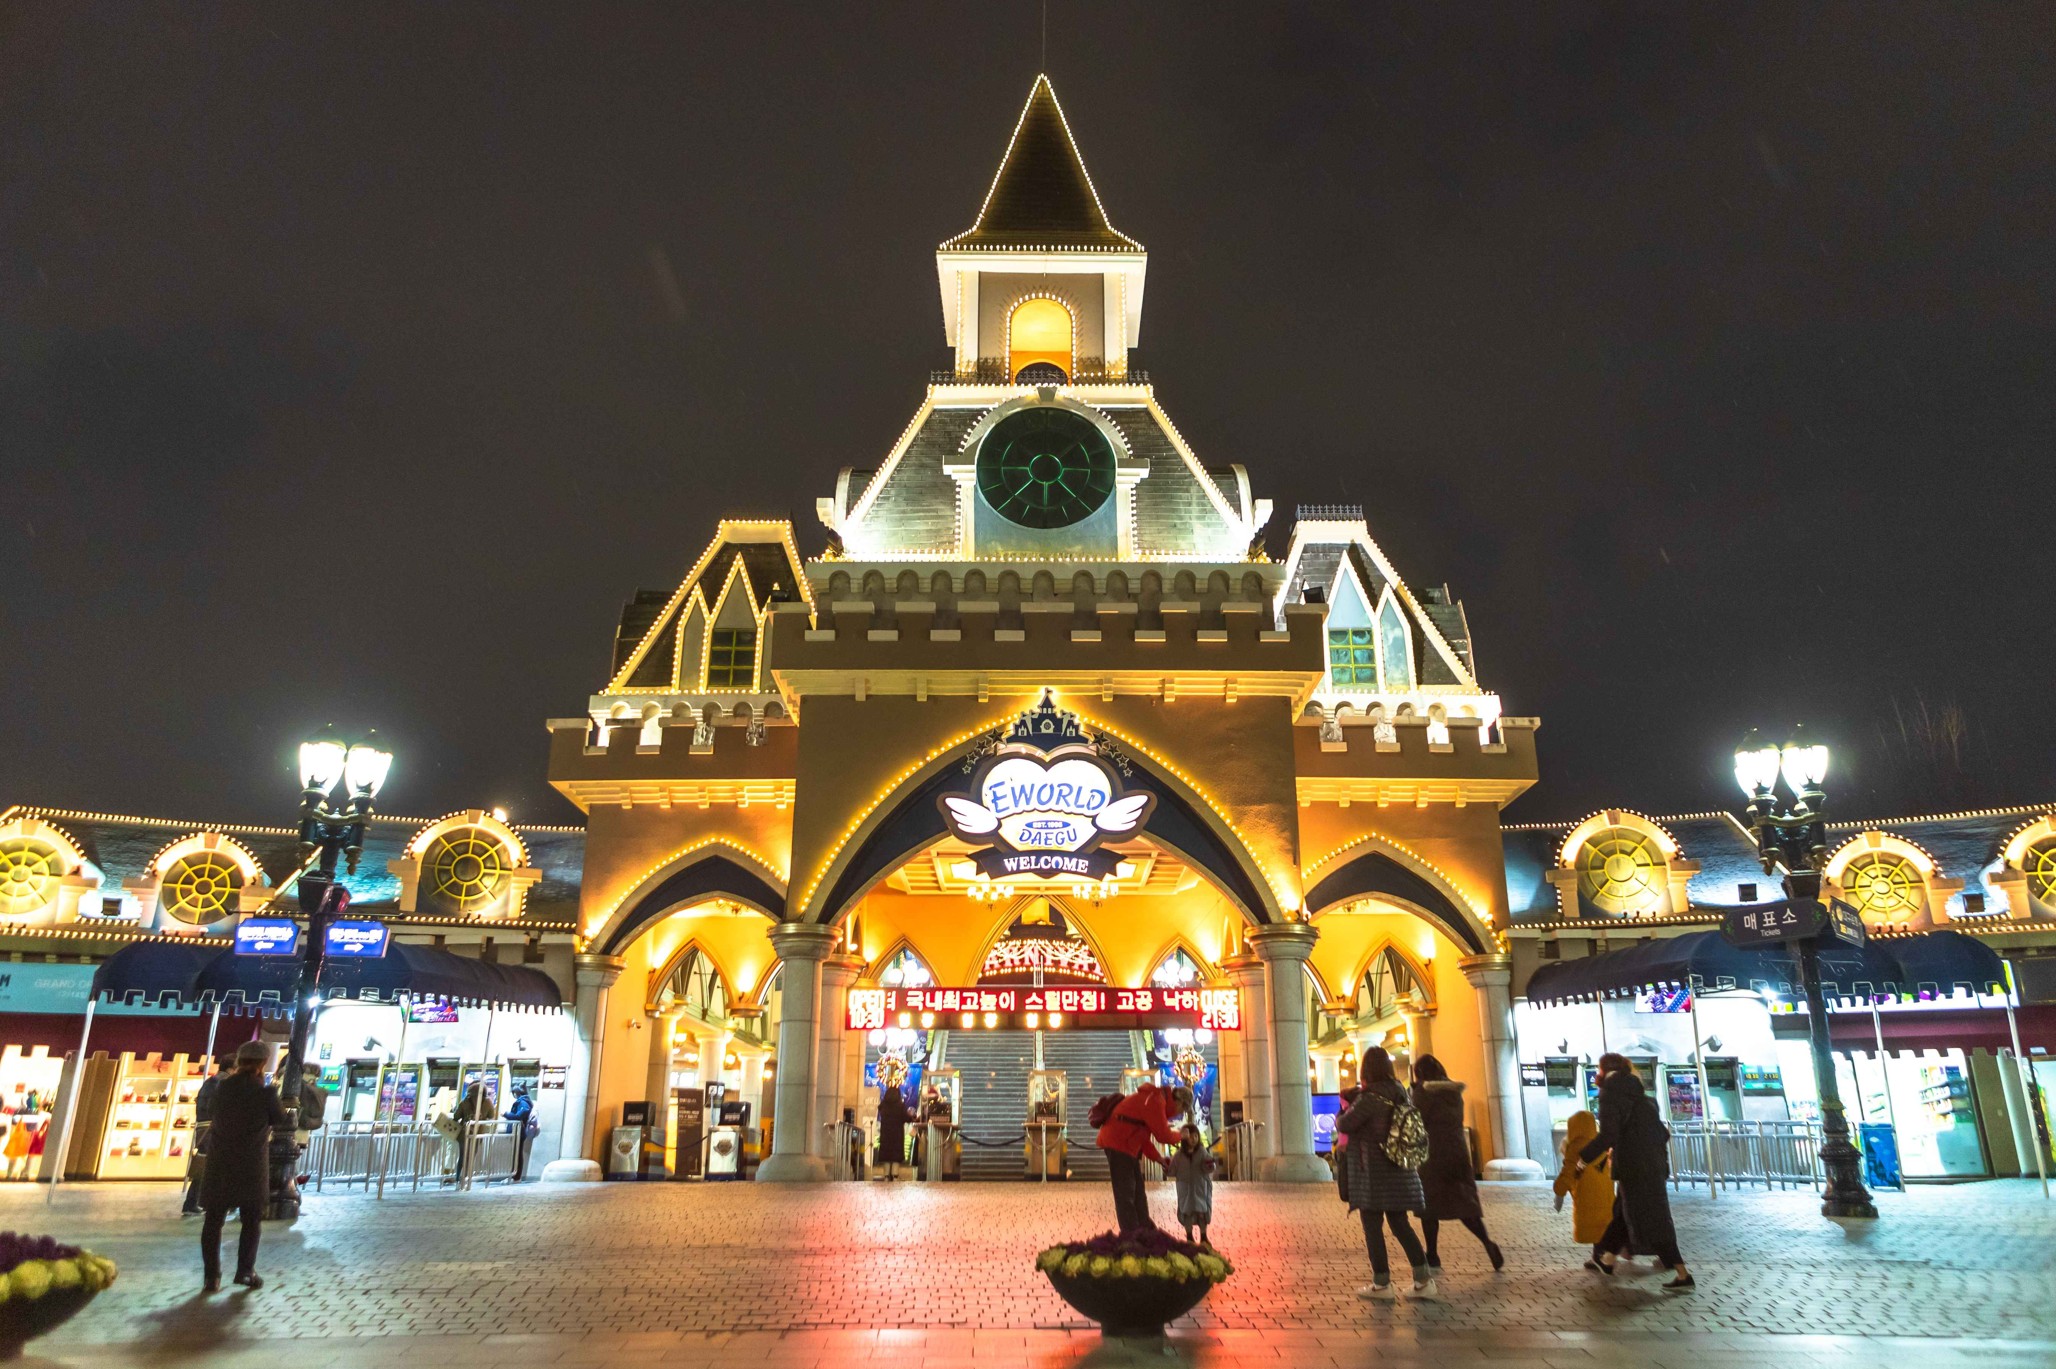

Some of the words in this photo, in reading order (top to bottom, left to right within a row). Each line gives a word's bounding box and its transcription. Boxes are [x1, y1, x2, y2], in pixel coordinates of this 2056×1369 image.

[989, 781, 1106, 813] EWORLD
[1018, 828, 1077, 846] DAEGU
[1003, 855, 1089, 873] WELCOME
[1743, 907, 1797, 930] 매표소
[1760, 928, 1781, 937] Tickets
[849, 989, 885, 1009] OPEN
[1201, 989, 1238, 1008] CLOSE
